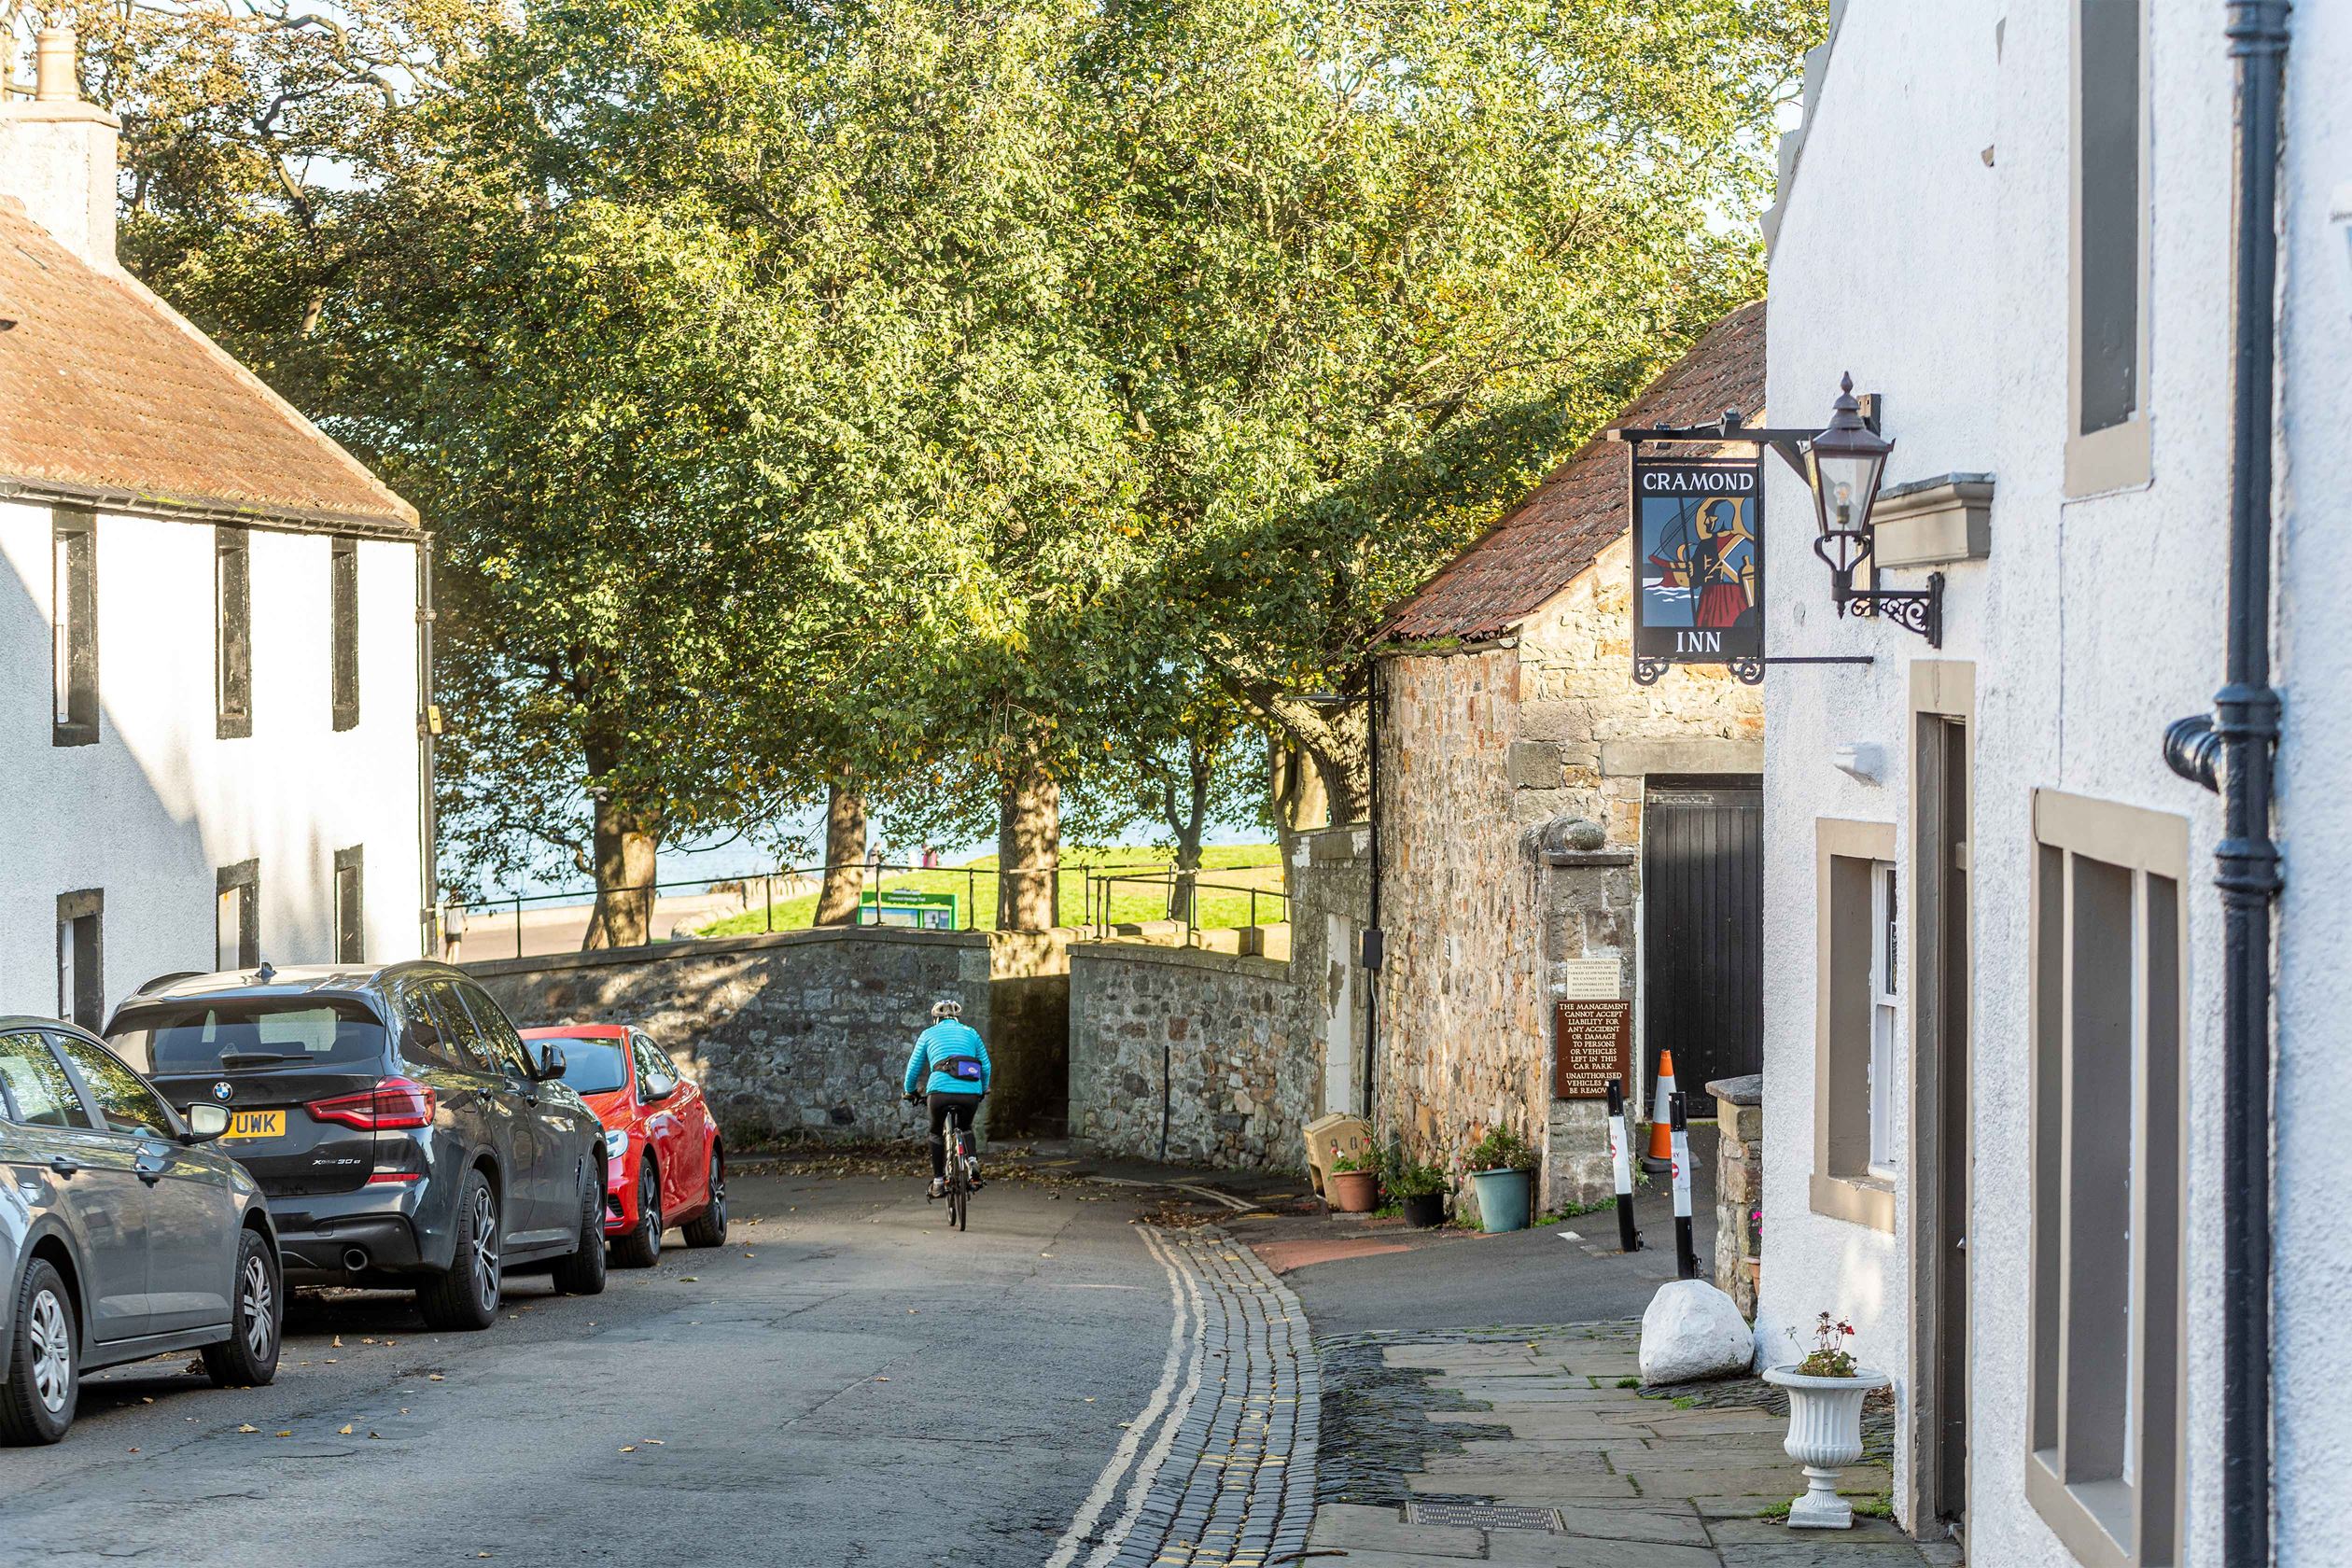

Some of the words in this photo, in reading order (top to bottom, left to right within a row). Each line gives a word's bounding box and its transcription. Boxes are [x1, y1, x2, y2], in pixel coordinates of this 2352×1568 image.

[1643, 473, 1754, 491] CRAMOND
[1675, 631, 1721, 652] INN
[236, 1114, 276, 1133] UWK
